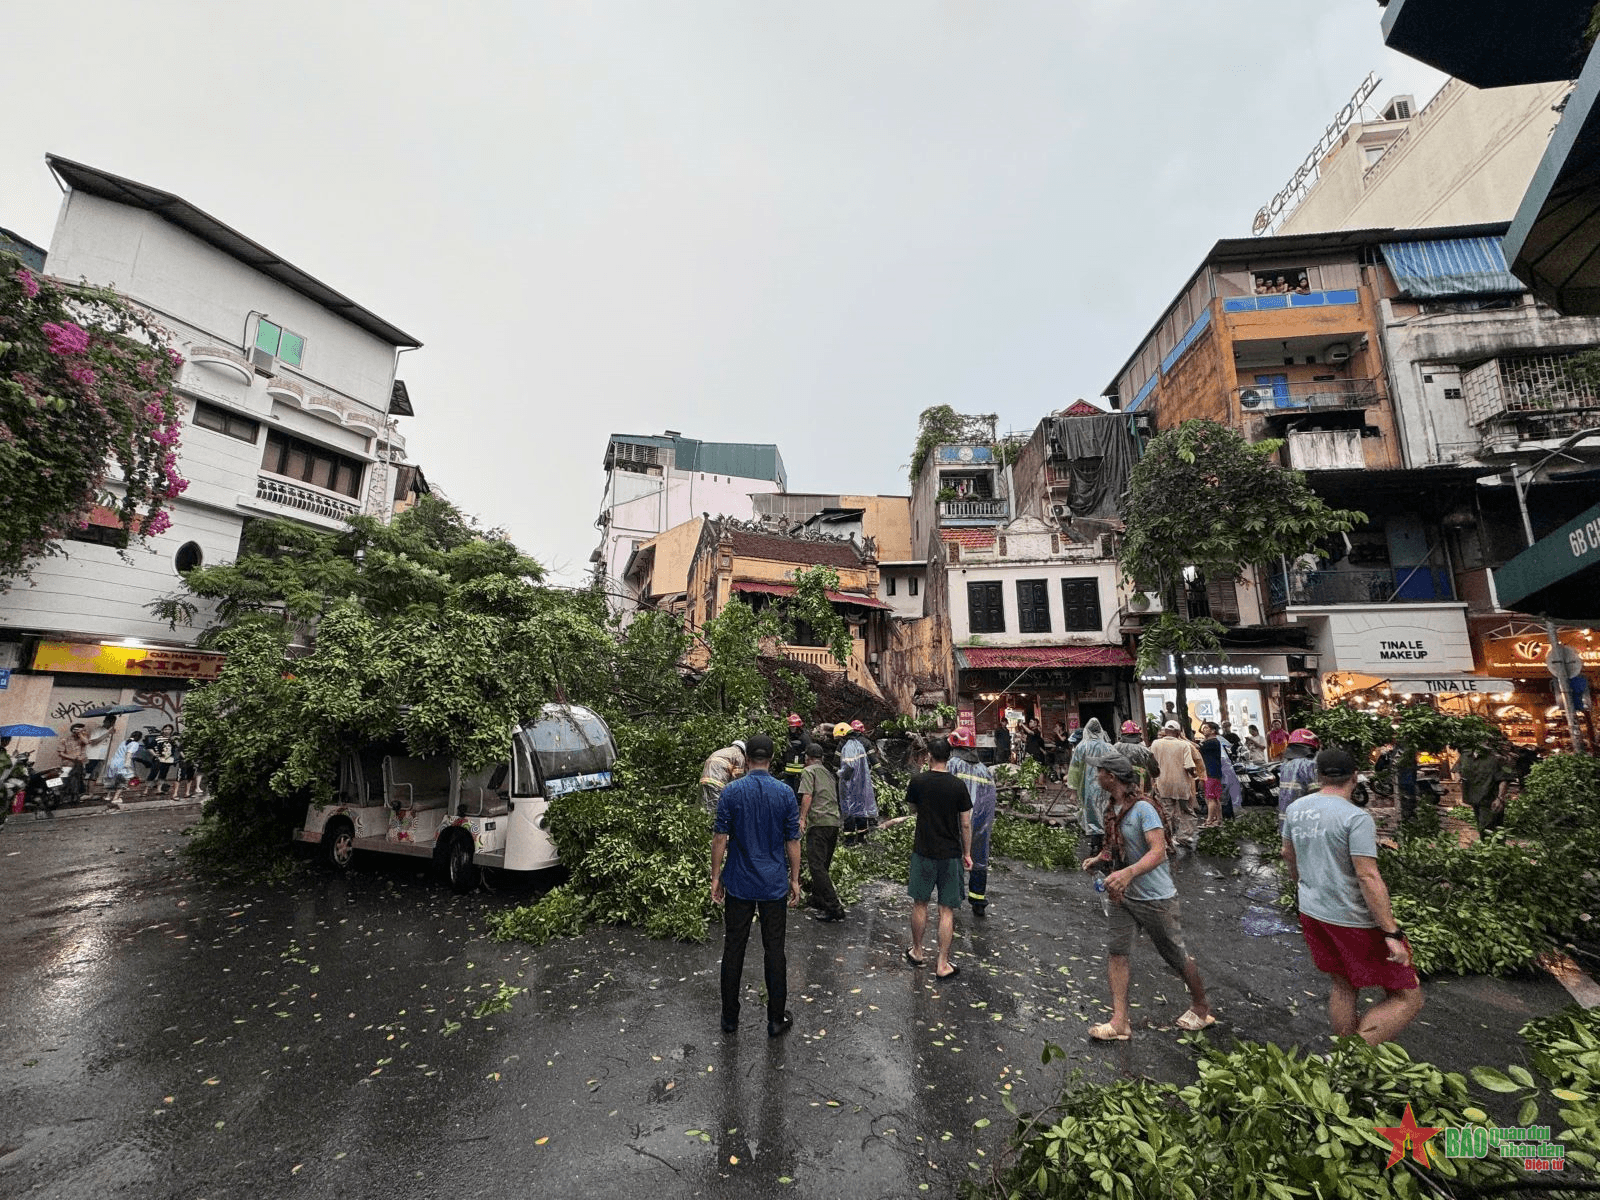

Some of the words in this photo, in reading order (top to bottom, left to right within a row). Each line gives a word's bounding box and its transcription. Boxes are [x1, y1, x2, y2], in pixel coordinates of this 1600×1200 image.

[1270, 140, 1325, 215] CHURCH
[1326, 70, 1381, 144] HOTEL
[1569, 528, 1588, 557] 6B
[1380, 640, 1407, 650] TINA
[1408, 640, 1424, 650] LE
[126, 658, 201, 671] KIM
[1194, 664, 1219, 675] Hair
[1220, 664, 1260, 675] Studio
[1425, 680, 1460, 692] TINA
[1462, 680, 1478, 692] LE
